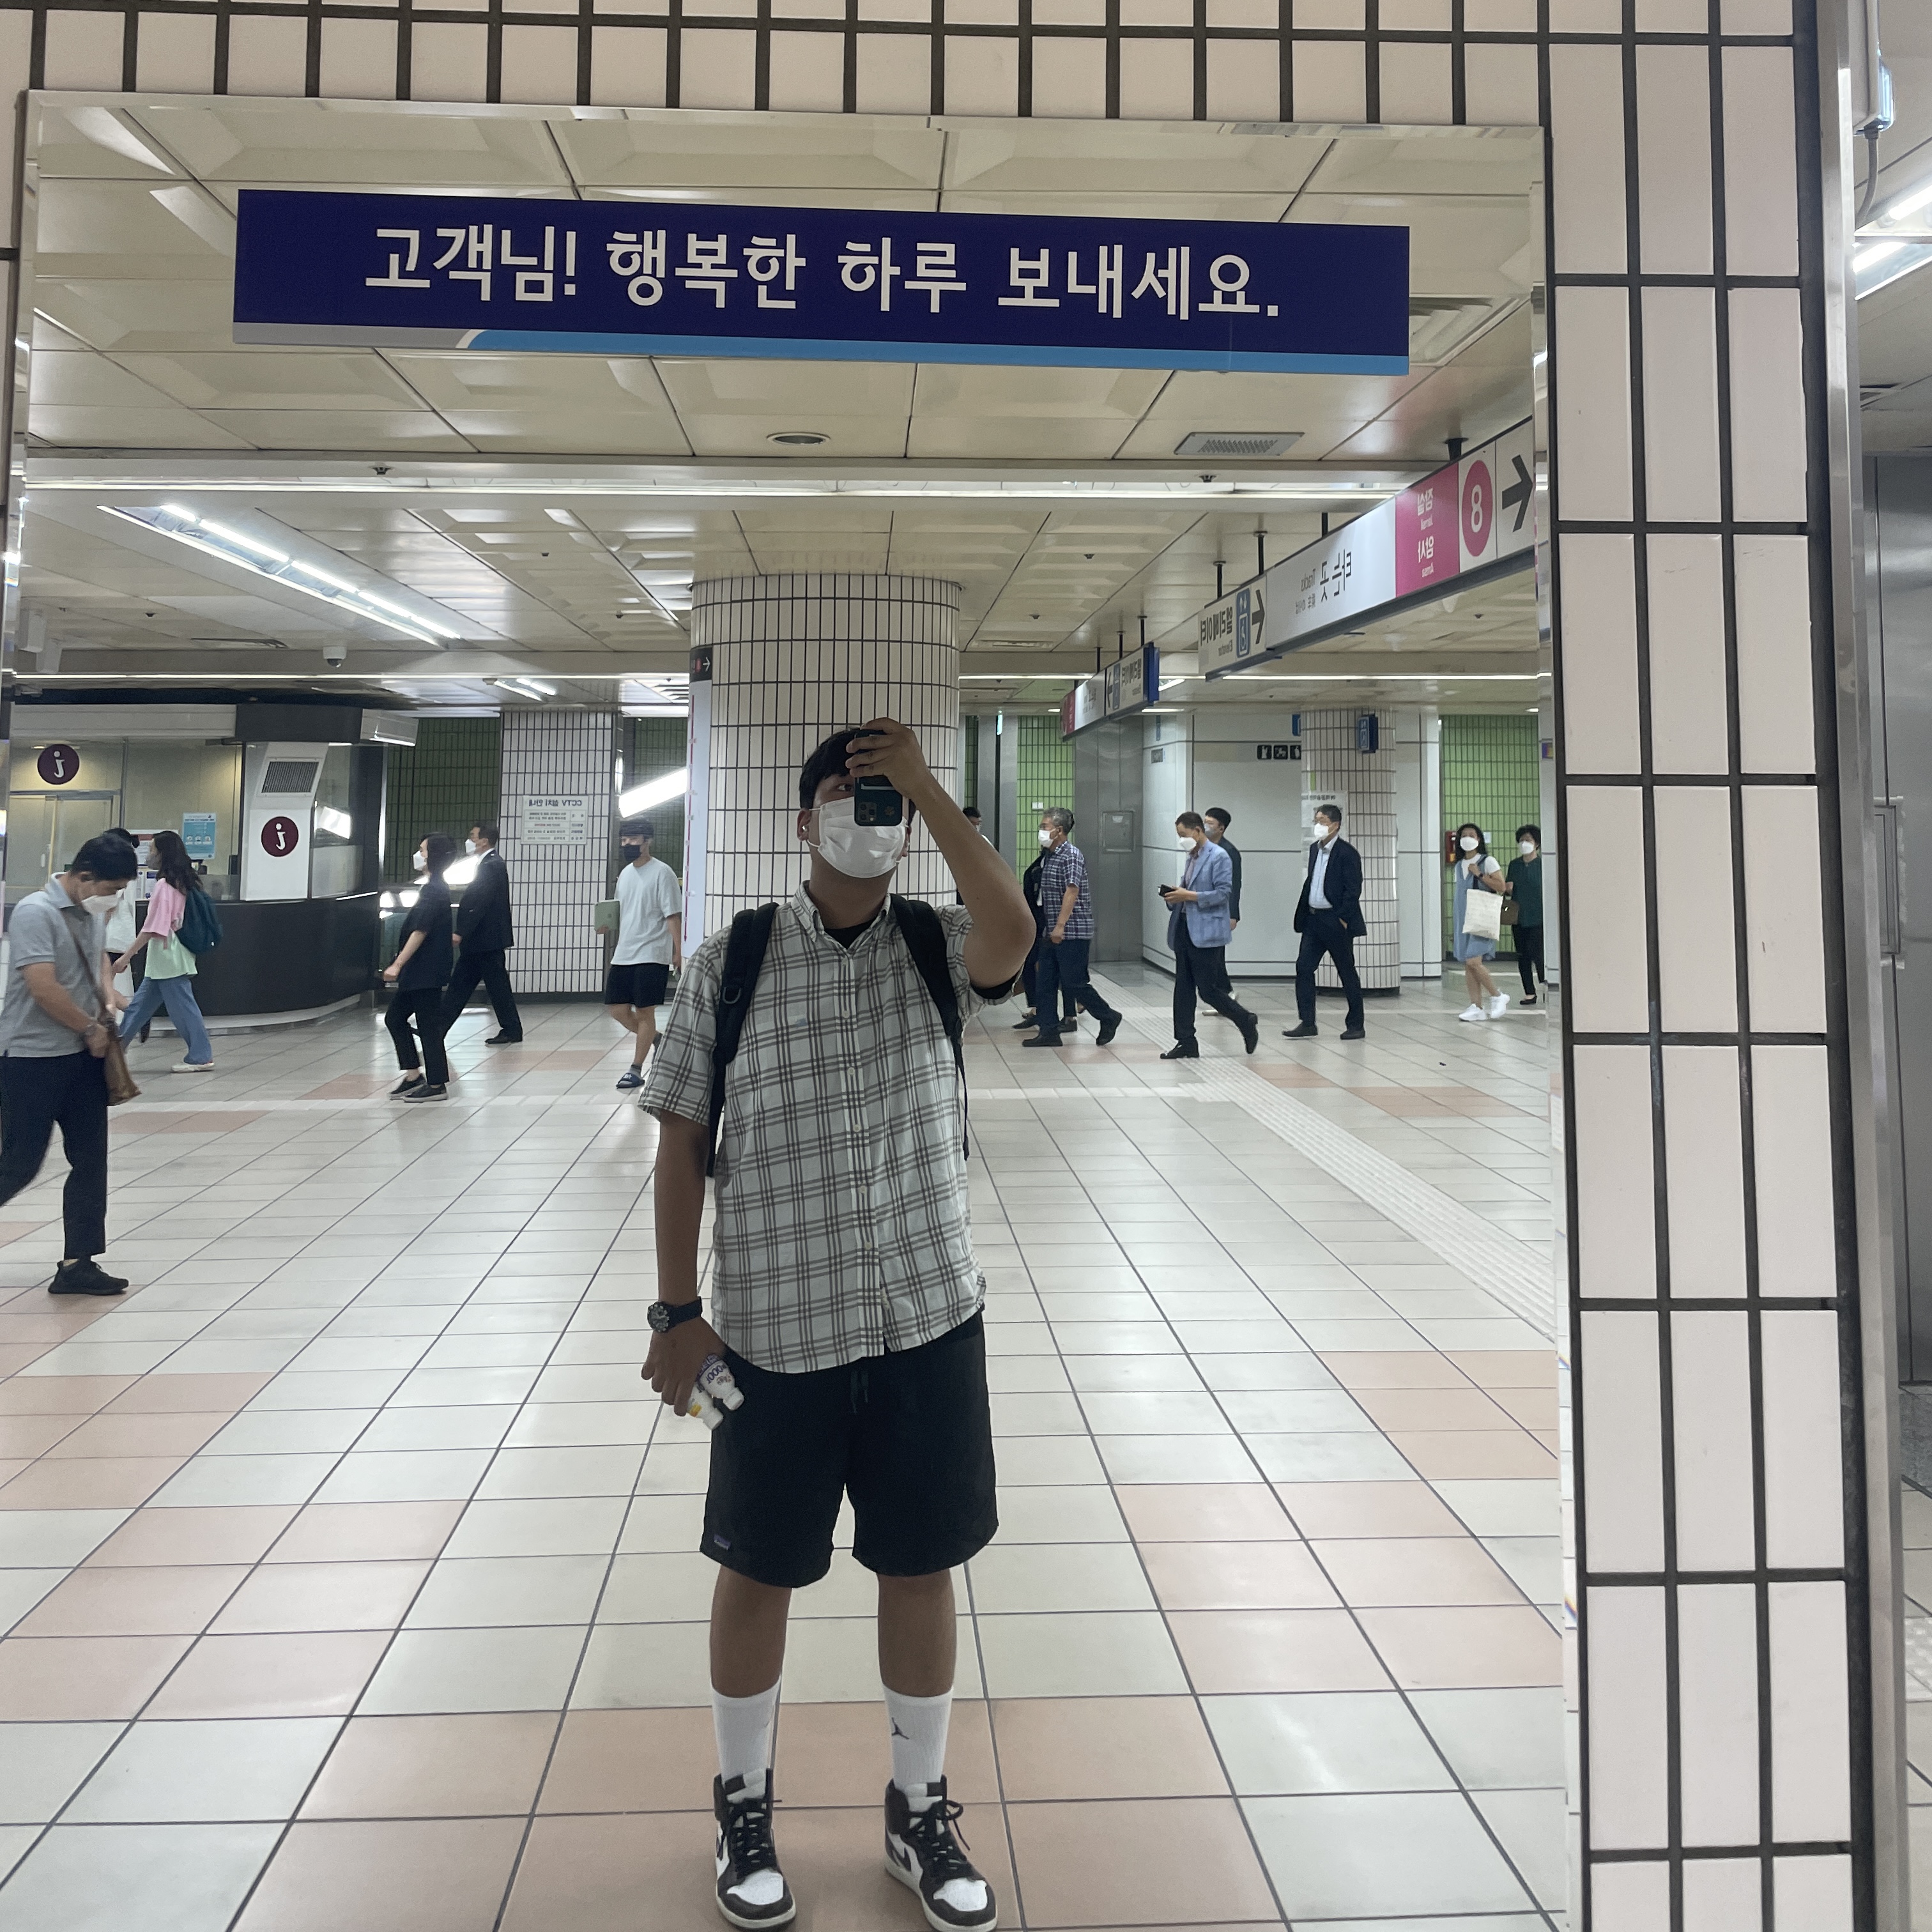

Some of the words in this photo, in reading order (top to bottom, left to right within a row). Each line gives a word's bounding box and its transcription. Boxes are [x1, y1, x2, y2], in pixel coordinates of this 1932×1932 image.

[365, 224, 576, 302] 고객님!
[606, 229, 806, 309] 행복한
[838, 237, 967, 314] 하루
[998, 244, 1278, 321] 보내세요.
